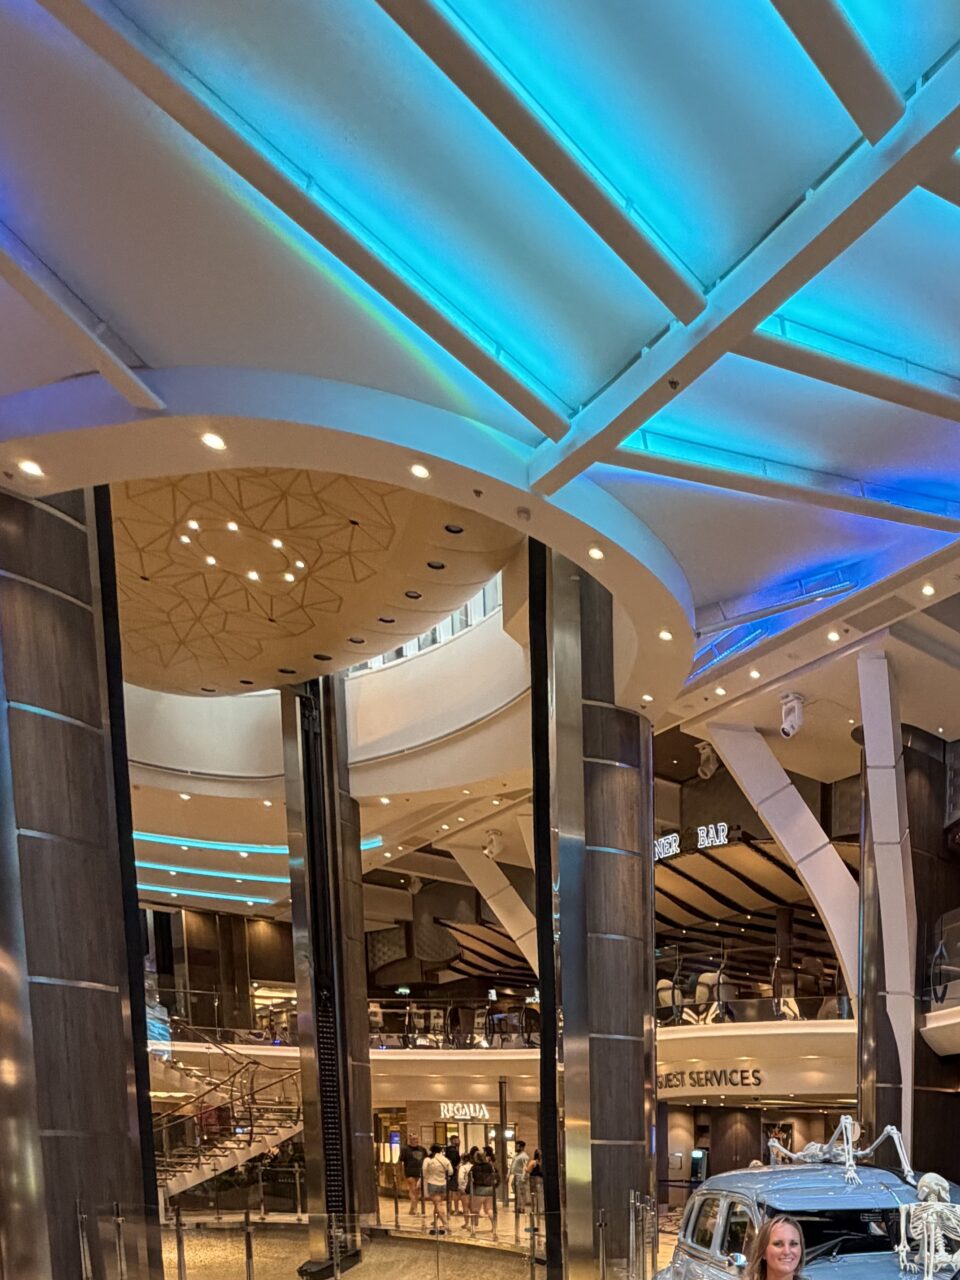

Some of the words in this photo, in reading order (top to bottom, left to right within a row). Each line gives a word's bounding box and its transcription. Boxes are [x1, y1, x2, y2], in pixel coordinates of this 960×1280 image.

[697, 822, 728, 848] BAR
[688, 1069, 762, 1087] SERVICES
[440, 1102, 490, 1119] REGALIA
